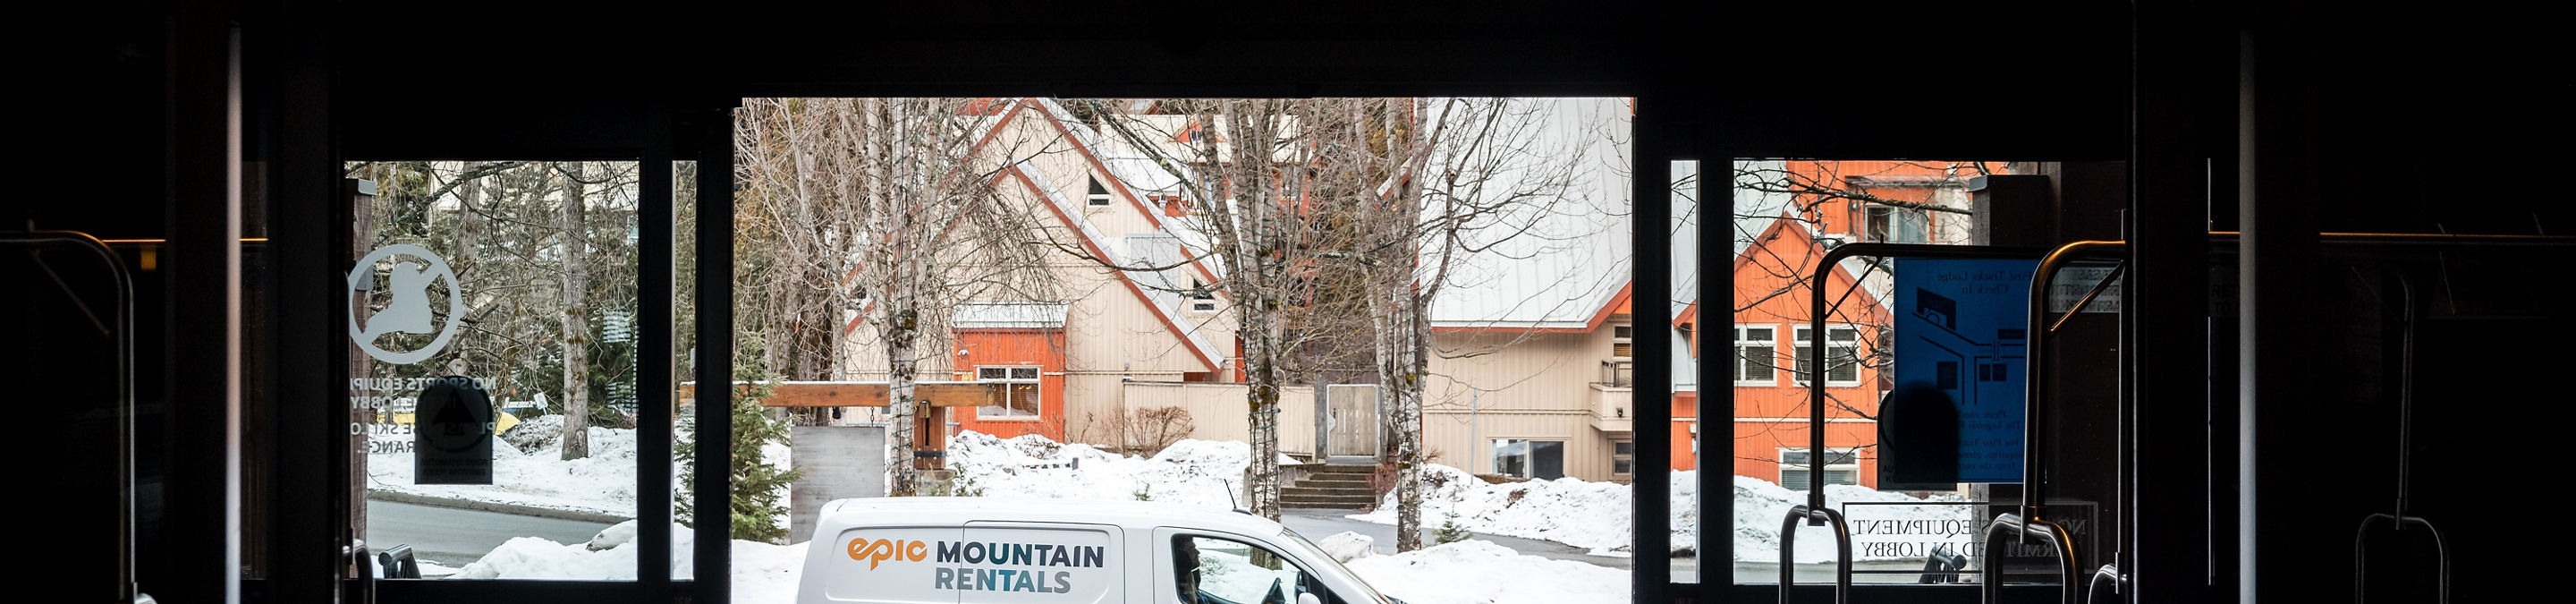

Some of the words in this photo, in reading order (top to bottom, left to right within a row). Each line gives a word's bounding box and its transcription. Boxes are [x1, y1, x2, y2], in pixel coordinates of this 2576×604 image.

[847, 537, 928, 571] epic
[936, 540, 1105, 568] MOUNTAIN
[935, 567, 1072, 593] RENTALS
